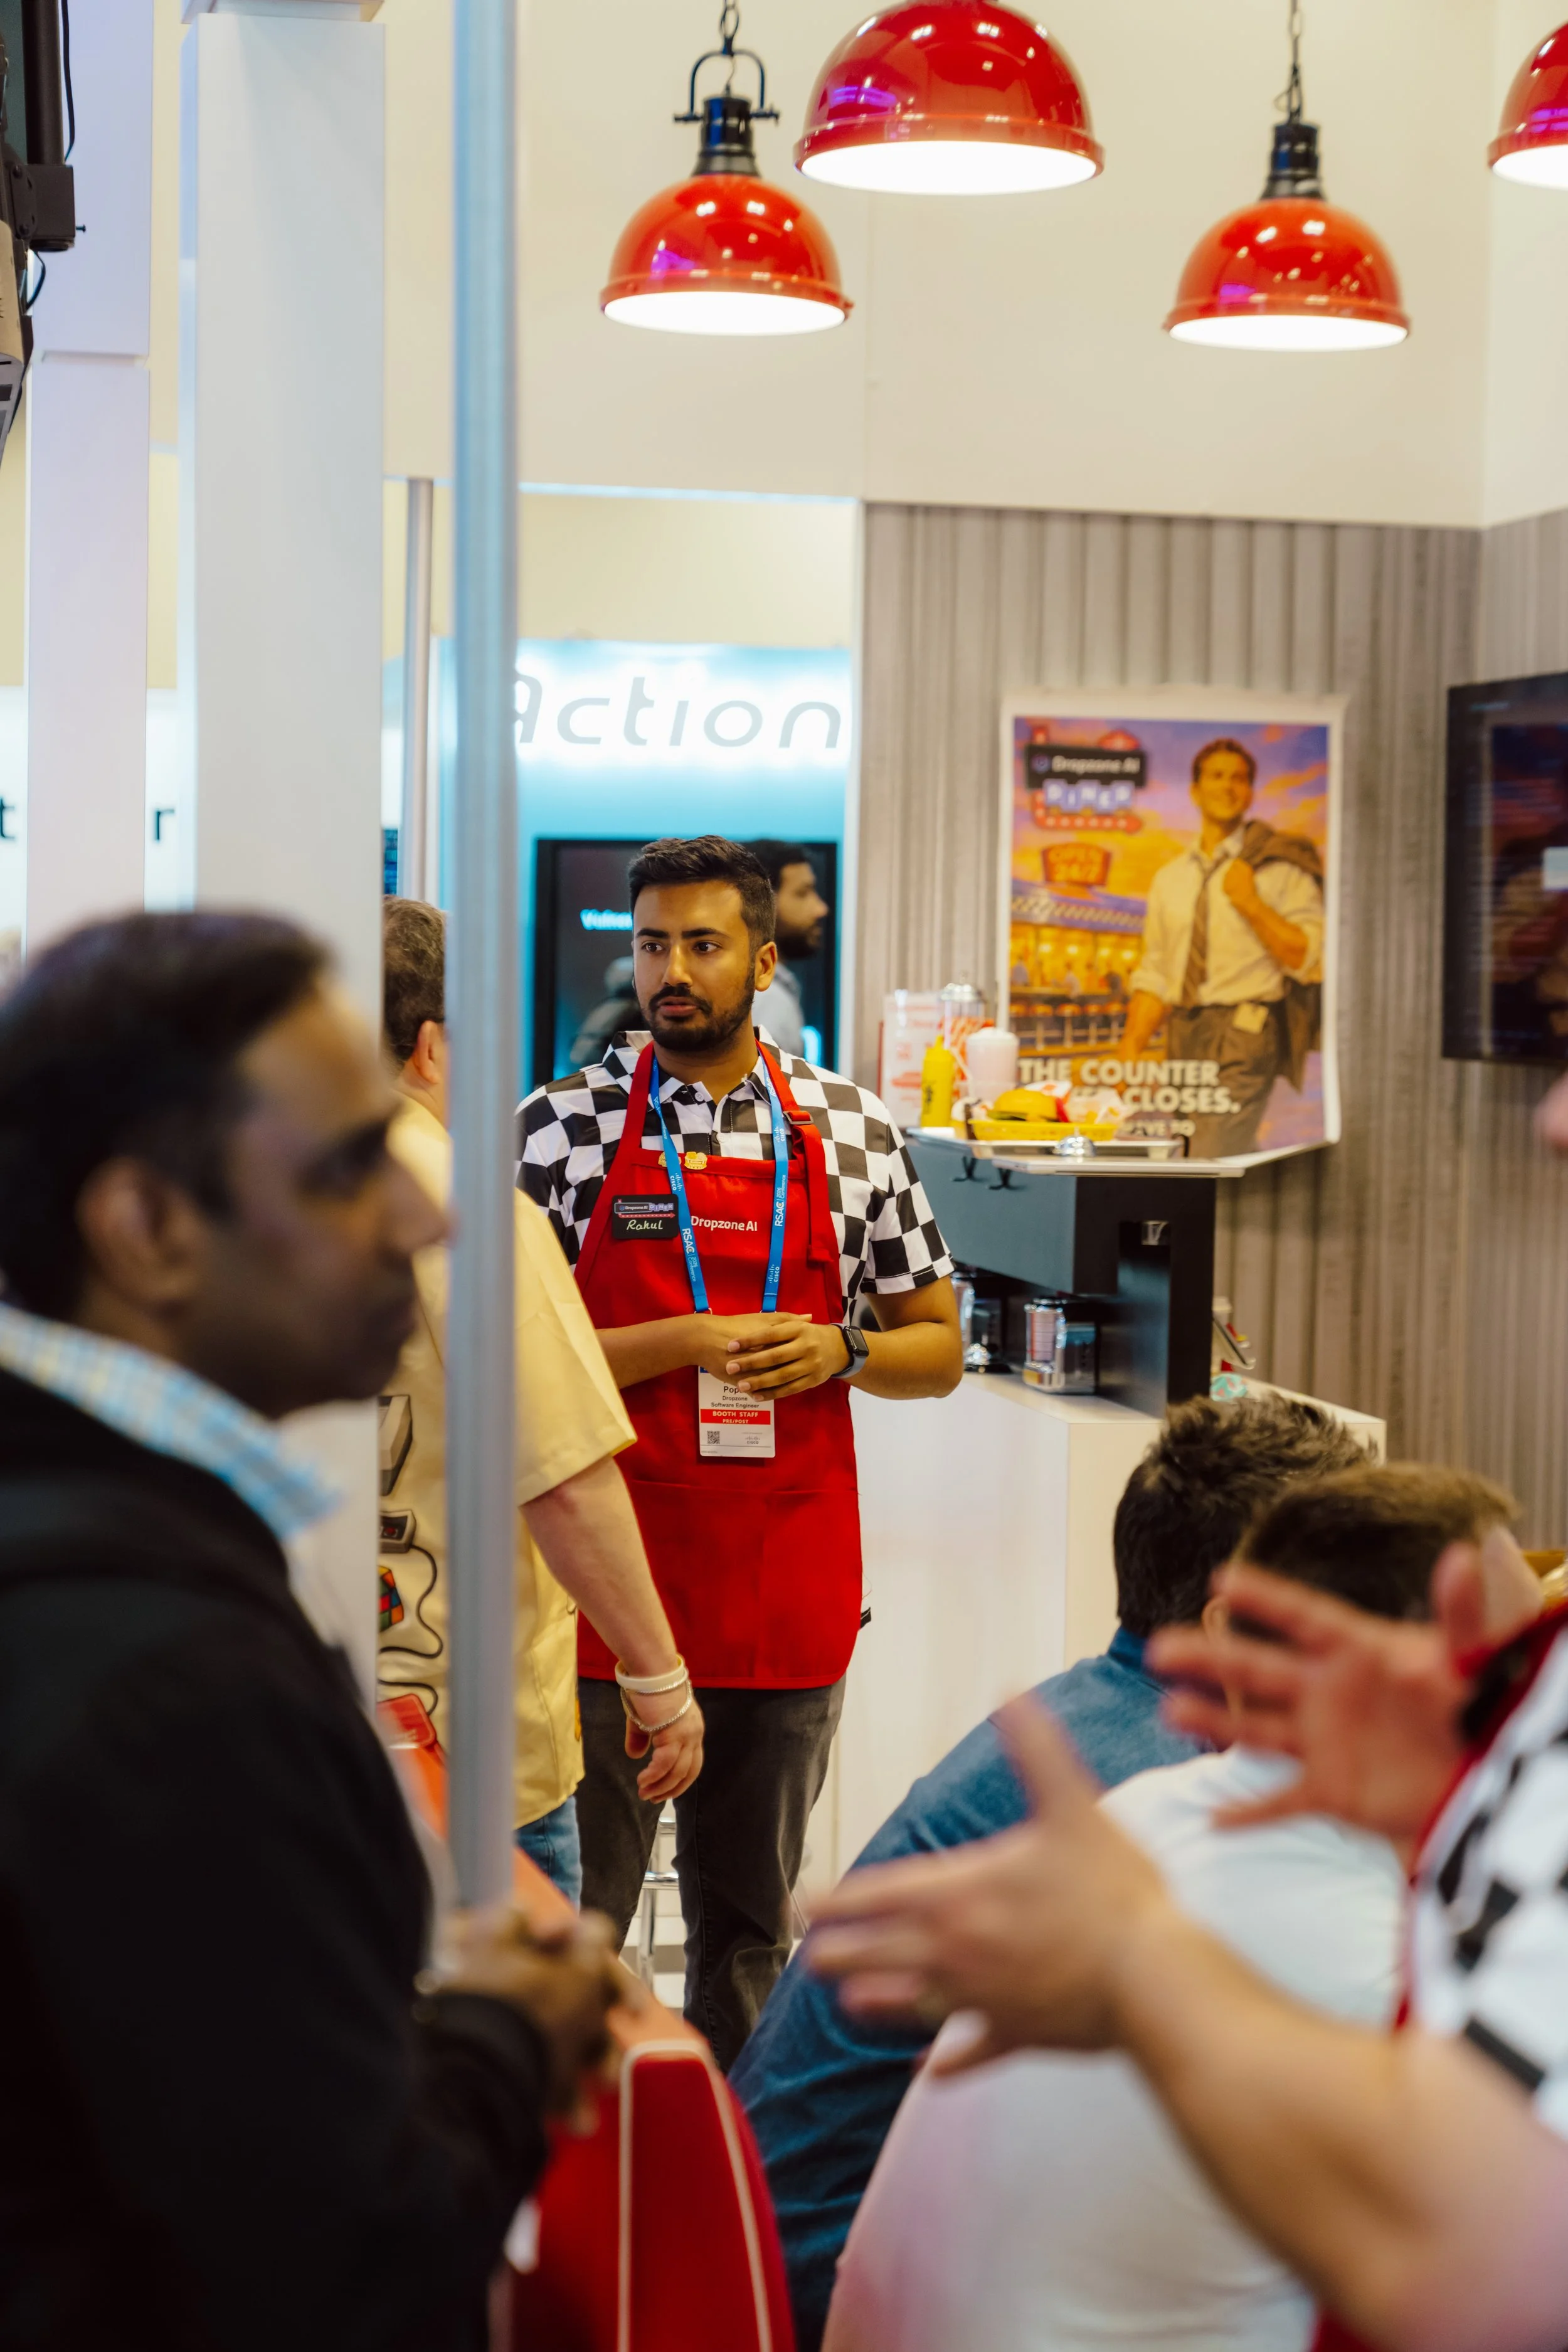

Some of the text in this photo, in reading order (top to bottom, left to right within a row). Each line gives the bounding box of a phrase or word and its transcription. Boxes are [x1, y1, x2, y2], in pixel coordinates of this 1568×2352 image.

[1017, 1057, 1221, 1086] THE COUNTER
[1122, 1086, 1242, 1114] CLOSES.
[626, 1219, 664, 1231] Rahul
[691, 1216, 758, 1232] Dropzone AI
[775, 1201, 784, 1227] RSAC
[682, 1227, 694, 1254] RSAC
